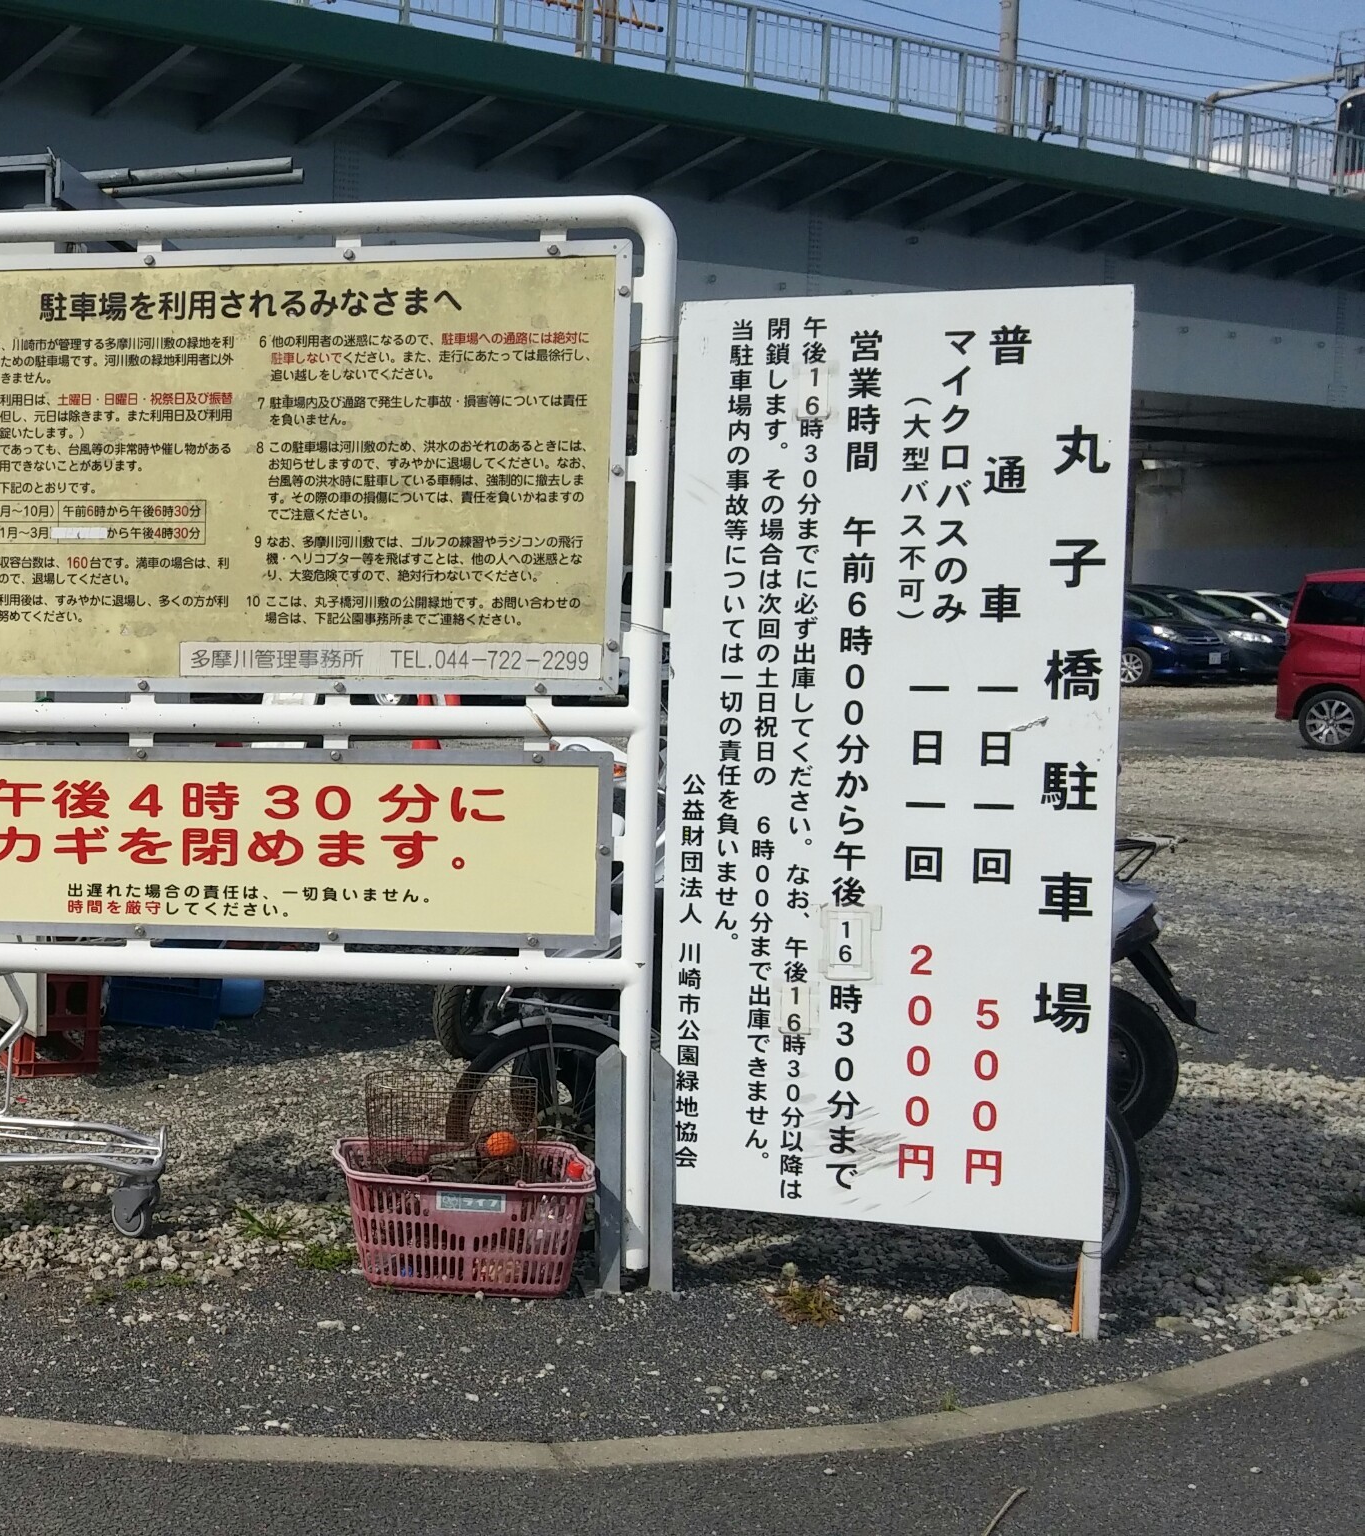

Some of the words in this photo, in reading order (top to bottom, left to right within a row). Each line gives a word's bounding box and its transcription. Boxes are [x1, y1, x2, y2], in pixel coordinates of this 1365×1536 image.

[39, 287, 462, 322] 駐車場を利用されるみなさまへ
[259, 336, 266, 348] 6
[272, 332, 589, 348] 他の利用者の迷惑になるので、駐車場への通路には絶対に
[271, 349, 590, 365] 駐車しないでください。また、走行にあたっては最徐行し、
[271, 368, 434, 382] 追い越しをしないでください。
[258, 398, 265, 409] 7
[270, 394, 588, 409] 駐車場内及び通路で発生した事故・損害等については責任
[846, 330, 882, 472] 営業時間
[270, 413, 346, 426] を負いません。
[257, 442, 263, 454] 8
[270, 440, 586, 454] この駐車場は河川敷のため、洪水のおそれのあるときには、
[269, 457, 586, 470] お知らせしますので、すみやかに退場してください。なお、
[932, 330, 976, 624] マイクロバスのみ
[268, 491, 584, 505] す。その際の車の損傷については、責任を負いかねますの
[63, 505, 201, 517] 午前6時から午後6時30分
[268, 508, 370, 522] でご注意ください。
[255, 537, 262, 548] 9
[267, 536, 583, 549] なお、多摩川河川敷では、ゴルフの練習やラジコンの飛行
[266, 569, 539, 582] り、大変危険ですので、絶対行わないでください。
[246, 596, 260, 608] 10
[266, 596, 580, 610] ここは、丸子橋河川敷の公開緑地です。お問い合わせの
[265, 612, 522, 626] 場合は、下記公園事務所までご連絡ください。
[715, 319, 753, 940] 当駐車場内の事故等については一切の責任を負いません。
[191, 649, 364, 669] 多摩川管理事務所
[1033, 425, 1111, 1034] 丸子橋駐車場
[68, 884, 432, 904] 出遅れた場合の責任は、一切負いません。
[67, 900, 290, 917] 時間を厳守してください。
